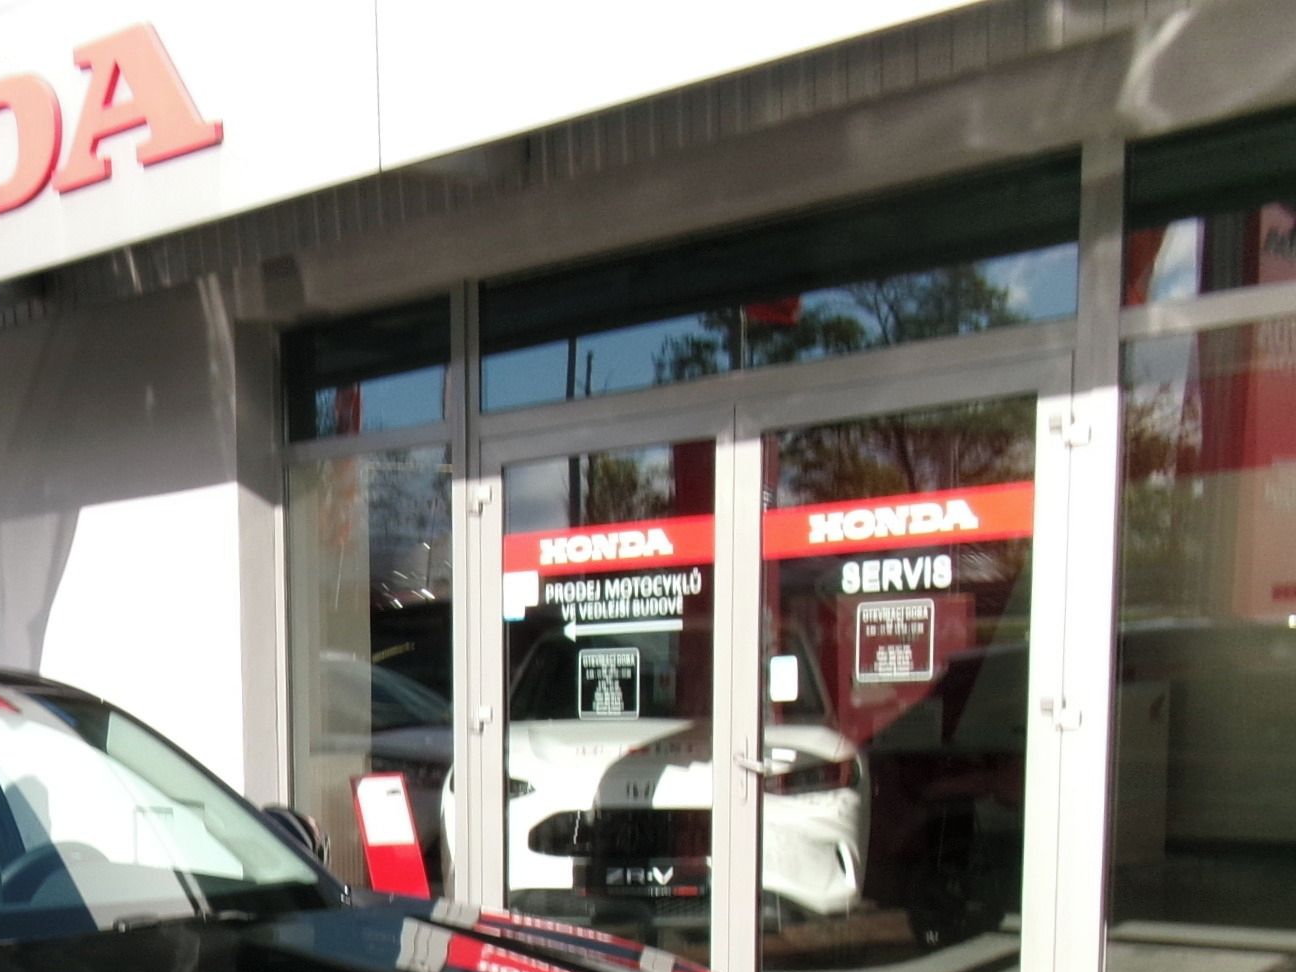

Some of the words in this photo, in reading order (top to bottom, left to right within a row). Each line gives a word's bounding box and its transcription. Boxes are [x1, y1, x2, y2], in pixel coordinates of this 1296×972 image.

[809, 499, 979, 544] HONDA
[540, 528, 674, 565] HONDA
[545, 580, 602, 604] PRODEJ
[605, 567, 702, 601] MOTOCYKLŮ
[841, 554, 953, 594] SERVIS
